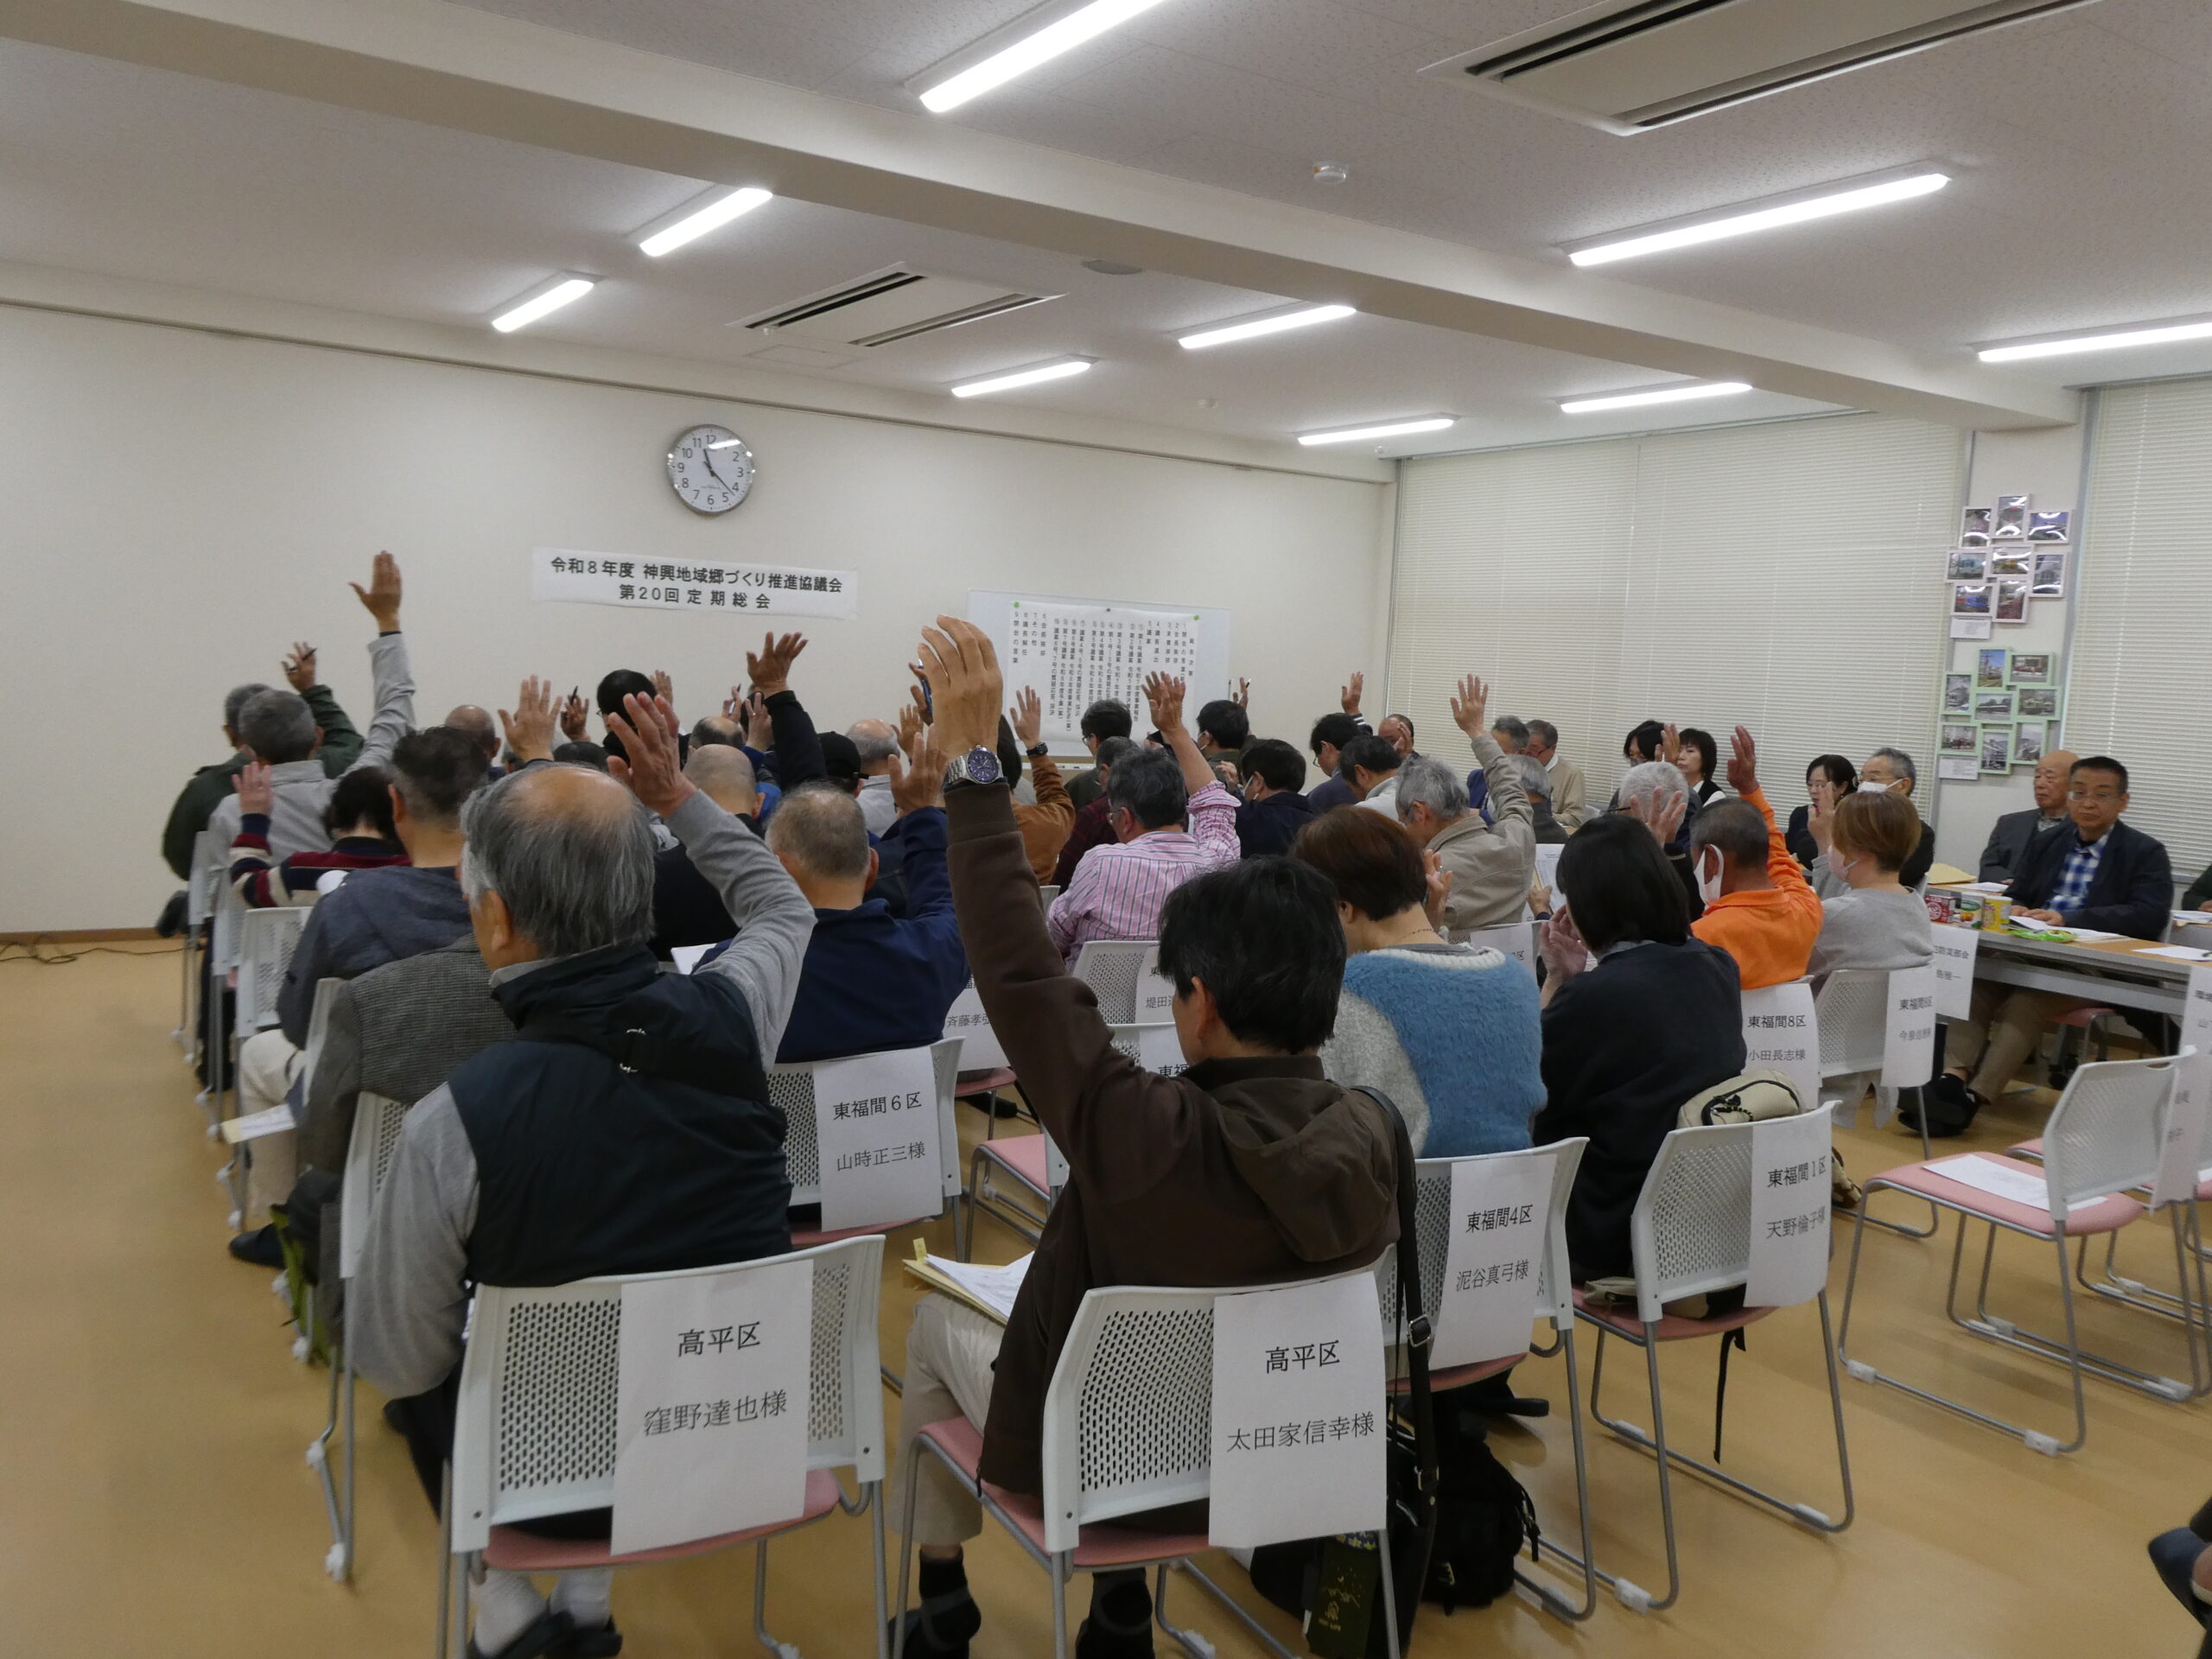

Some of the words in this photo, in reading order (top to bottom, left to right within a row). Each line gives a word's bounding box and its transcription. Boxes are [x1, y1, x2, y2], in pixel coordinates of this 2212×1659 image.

[692, 437, 702, 448] 11
[681, 448, 693, 459] 10
[732, 451, 740, 462] 2
[677, 462, 684, 473] 9
[736, 467, 744, 478] 3
[681, 477, 689, 488] 8
[731, 482, 739, 493] 4
[693, 489, 700, 499] 7
[707, 494, 715, 505] 6
[721, 492, 729, 503] 5
[550, 556, 635, 579] 令和8年度
[643, 563, 842, 593] 神興地域郷づくり推進協議会
[620, 584, 680, 604] 第20回
[1747, 1014, 1807, 1028] 東福間8区
[1748, 1048, 1806, 1061] 小田長志様
[833, 1091, 922, 1121] 東福間6区
[836, 1141, 925, 1172] 山時正三様
[1767, 1155, 1827, 1188] 東福間1区
[1465, 1205, 1534, 1233] 東福間4区
[1456, 1259, 1529, 1292] 泥谷真弓様
[677, 1321, 761, 1357] 高平区
[1265, 1340, 1340, 1374] 高平区
[644, 1389, 787, 1437] 窪野達也様
[1227, 1411, 1374, 1452] 太田家信幸様
